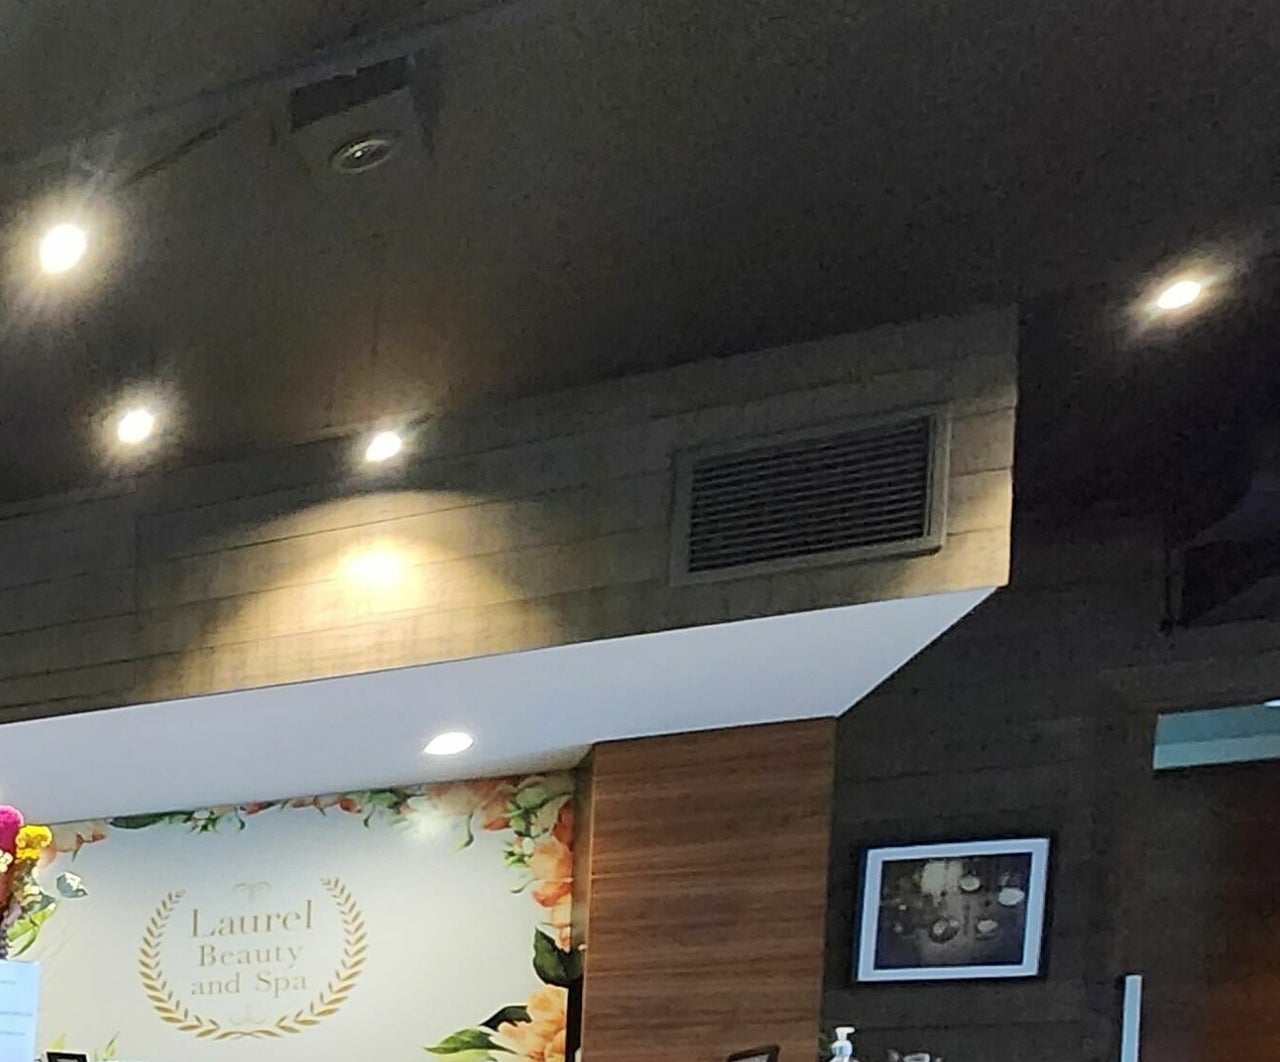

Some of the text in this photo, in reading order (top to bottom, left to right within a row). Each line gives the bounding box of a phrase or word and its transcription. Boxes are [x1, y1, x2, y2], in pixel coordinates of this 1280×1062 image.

[191, 899, 313, 938] Laurel
[198, 944, 303, 968] Beauty
[190, 970, 308, 999] and Spa
